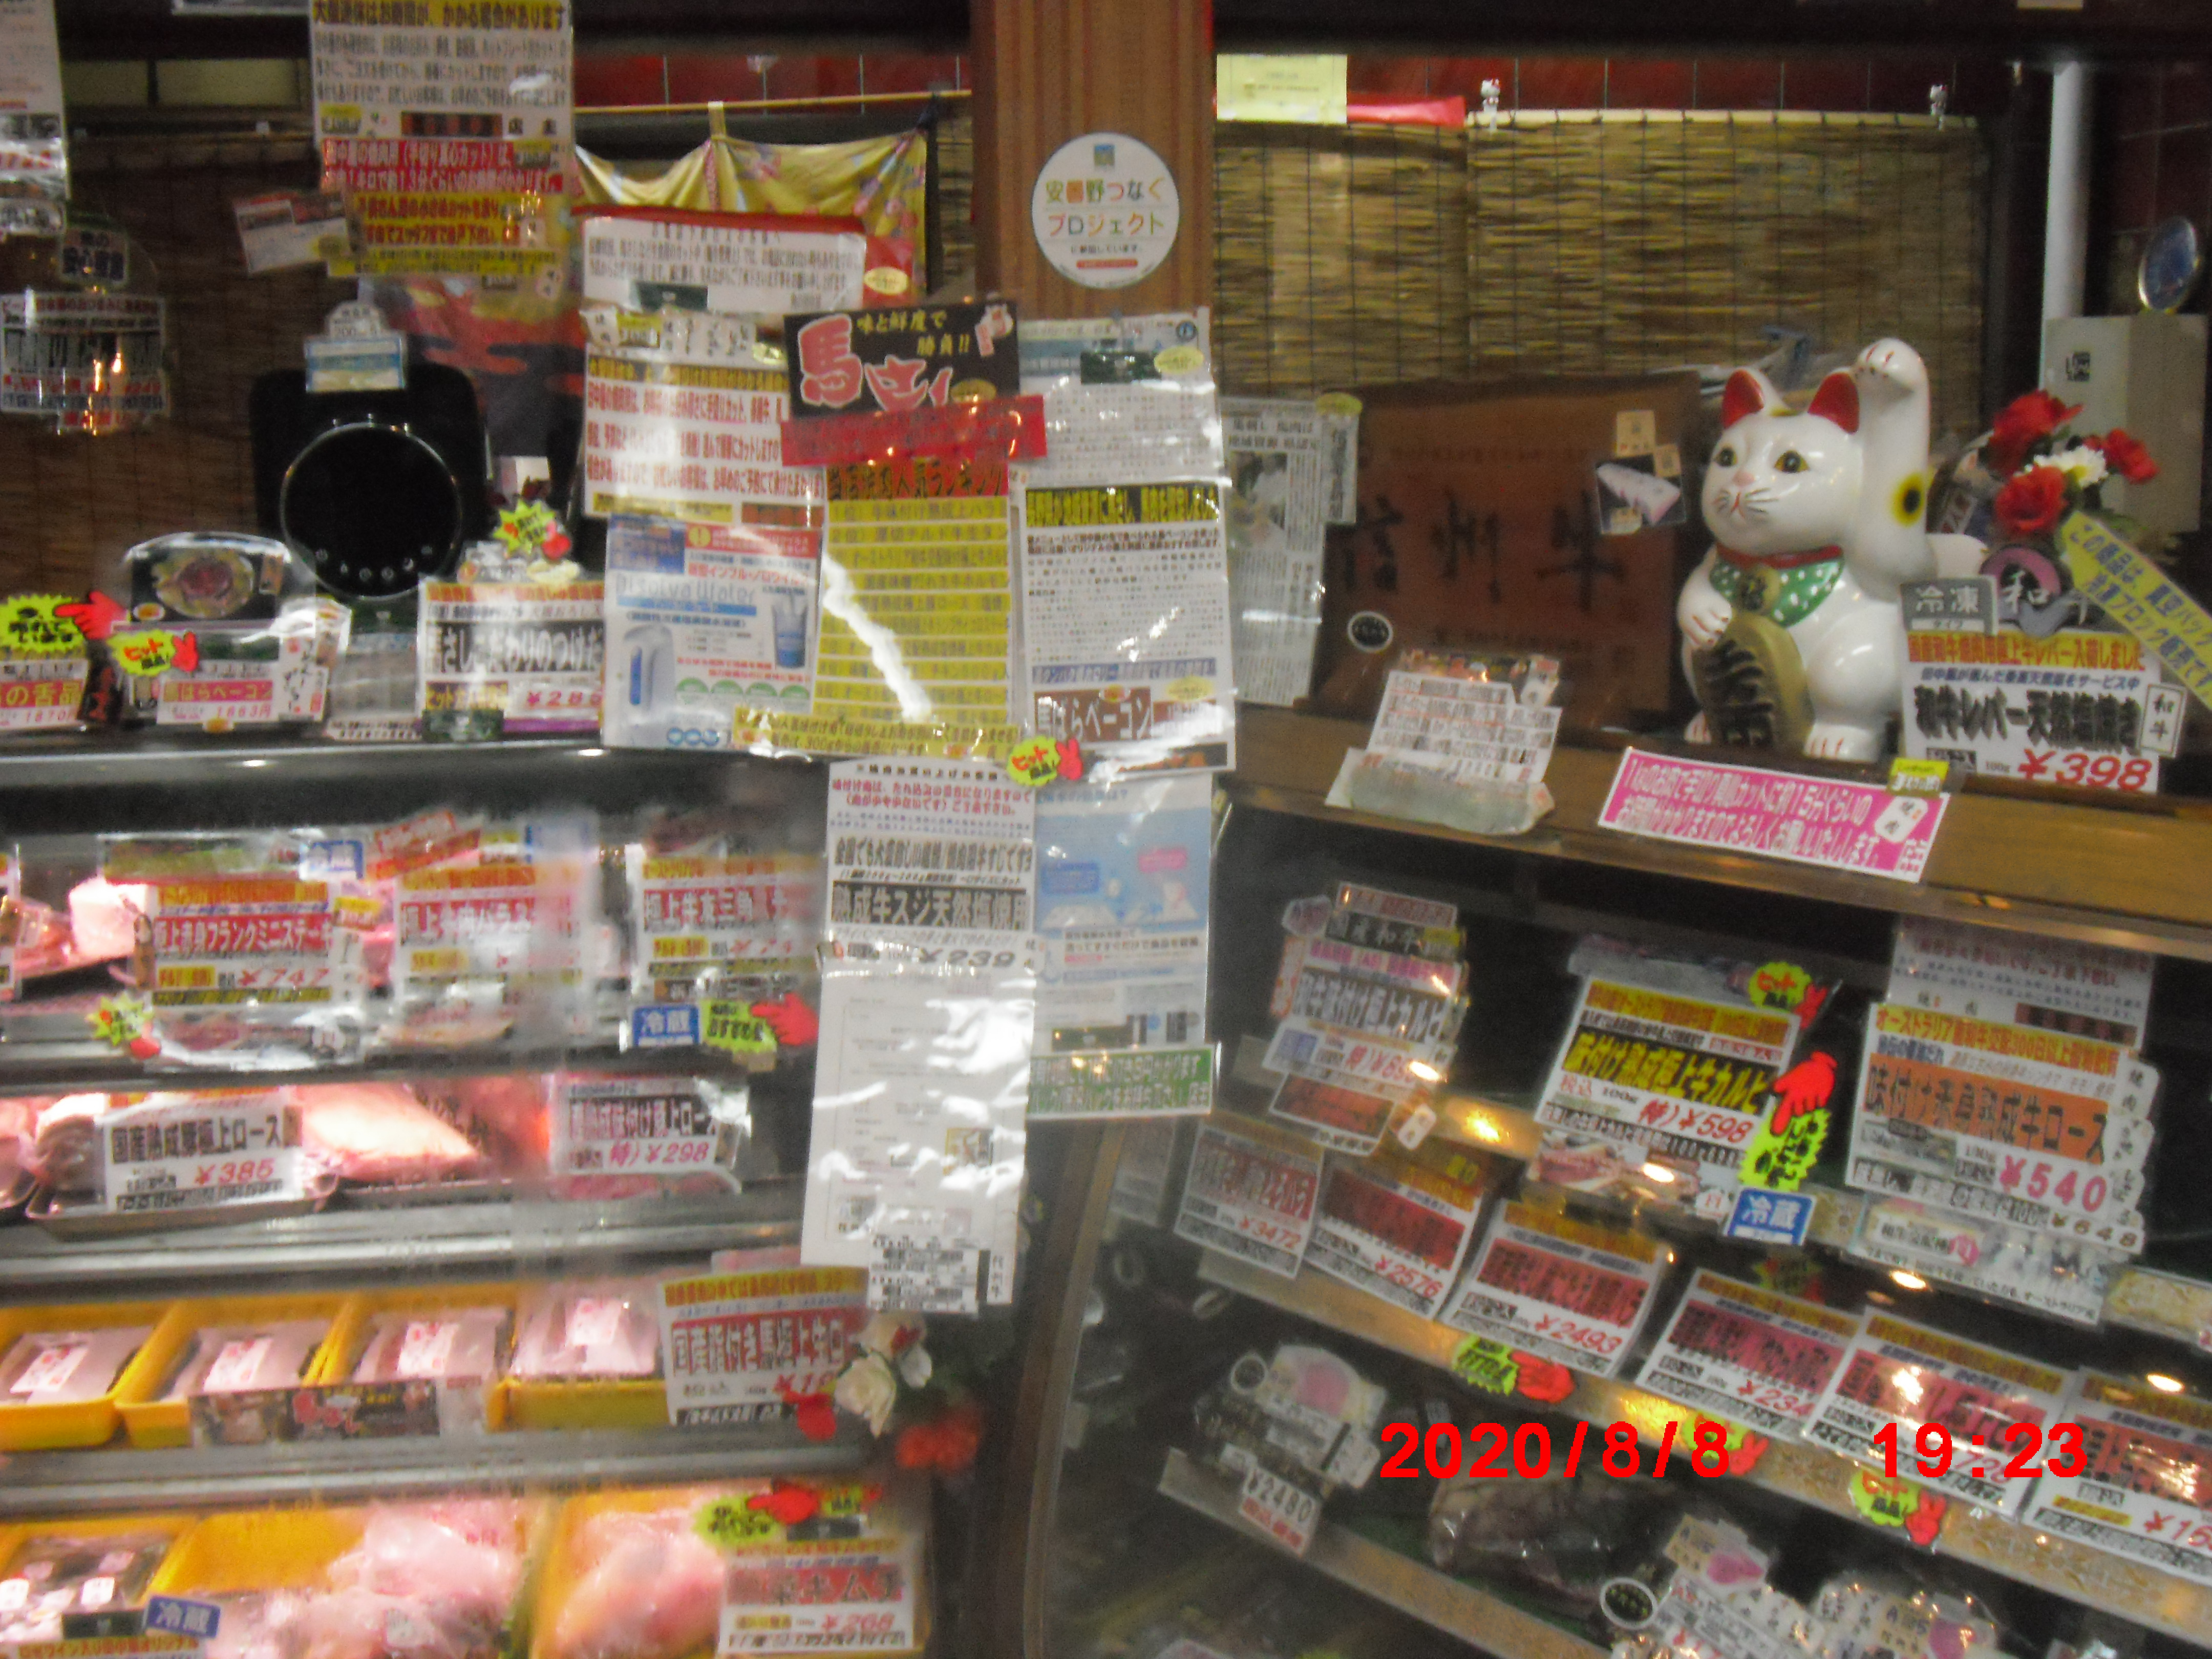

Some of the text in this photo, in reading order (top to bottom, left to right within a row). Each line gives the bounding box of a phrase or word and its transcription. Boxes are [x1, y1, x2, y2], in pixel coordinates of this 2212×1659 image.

[1048, 211, 1164, 237] プロジェクト
[1915, 585, 1980, 613] 冷凍
[2018, 749, 2152, 792] ¥398
[1999, 1155, 2107, 1213] ¥540
